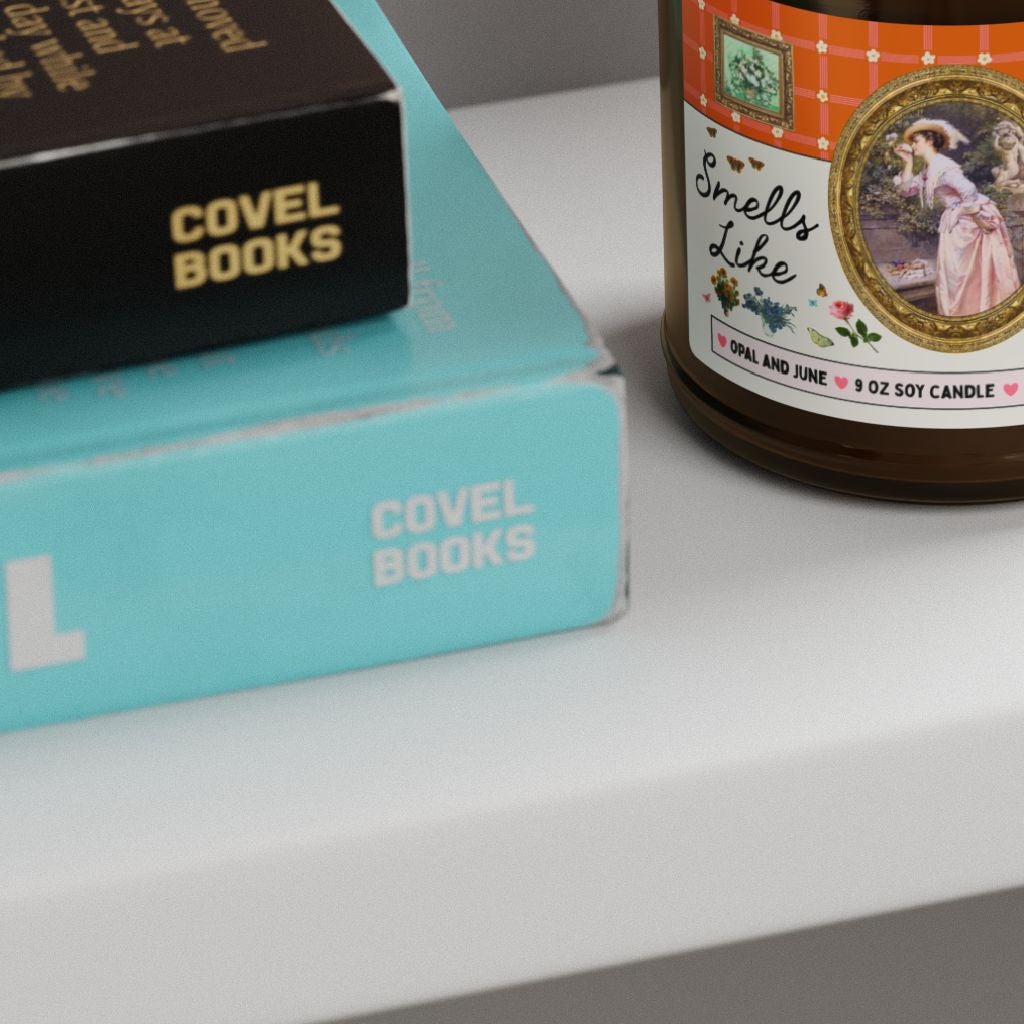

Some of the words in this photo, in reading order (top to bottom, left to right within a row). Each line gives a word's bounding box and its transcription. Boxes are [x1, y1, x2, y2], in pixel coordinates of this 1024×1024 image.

[4, 3, 52, 36] day
[76, 17, 140, 55] and
[145, 26, 192, 49] at
[169, 180, 342, 245] COVEL
[695, 149, 819, 241] Smells
[172, 222, 344, 291] BOOKS
[709, 220, 797, 284] Like
[729, 339, 760, 365] OPAL
[762, 354, 790, 375] AND
[793, 364, 828, 386] JUNE
[854, 378, 864, 393] 9
[868, 380, 890, 396] OZ
[894, 383, 926, 399] SOY
[929, 383, 996, 400] CANDLE
[370, 479, 537, 541] COVEL
[372, 523, 538, 589] BOOKS
[4, 553, 87, 672] L
